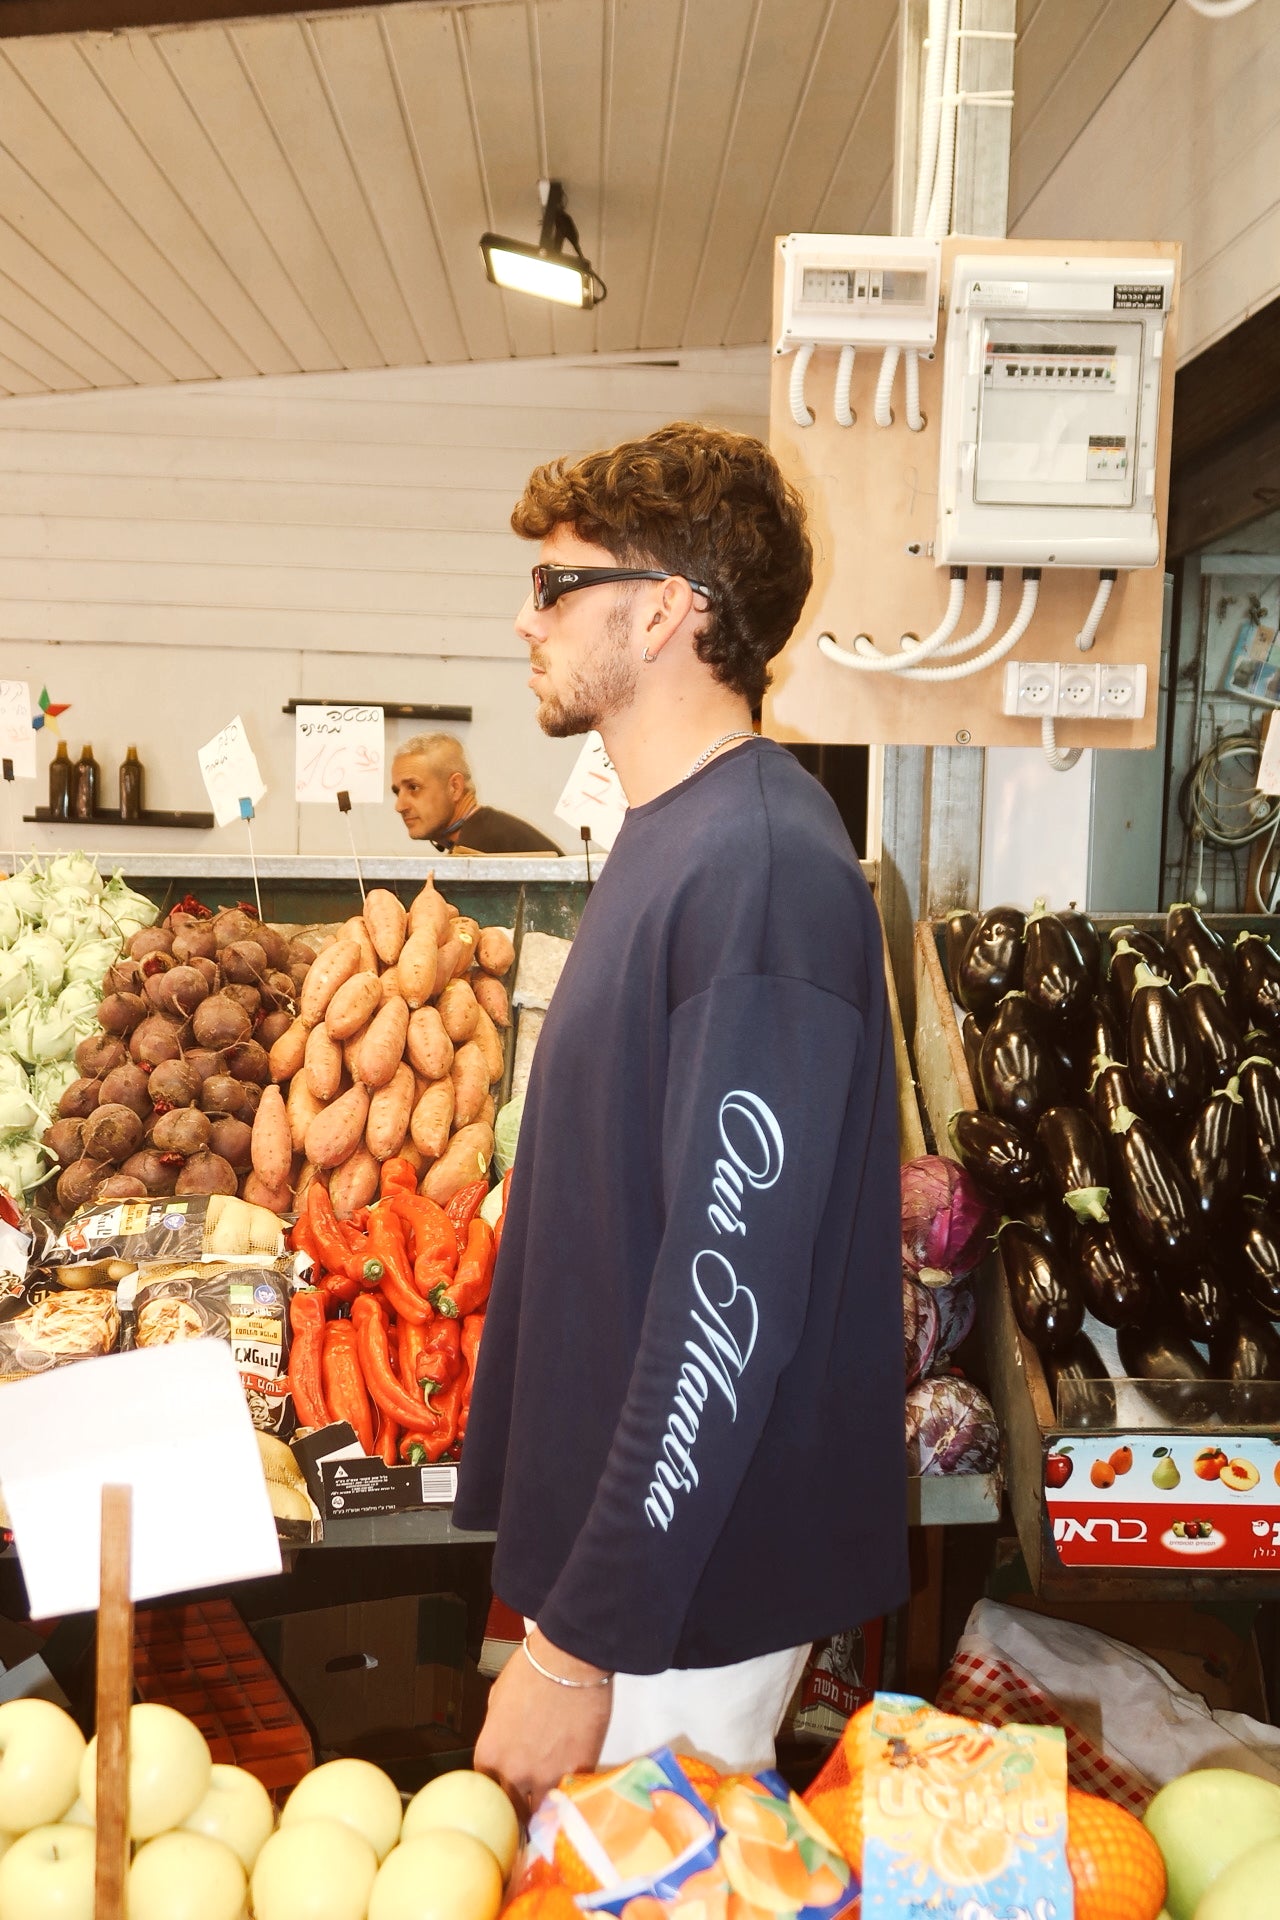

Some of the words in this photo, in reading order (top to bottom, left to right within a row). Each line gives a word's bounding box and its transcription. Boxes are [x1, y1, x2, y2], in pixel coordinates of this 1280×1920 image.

[1145, 294, 1161, 302] שוק
[707, 1090, 785, 1237] Our
[235, 1348, 278, 1369] לאפייה
[644, 1249, 759, 1532] Mantra
[813, 1677, 839, 1702] משה
